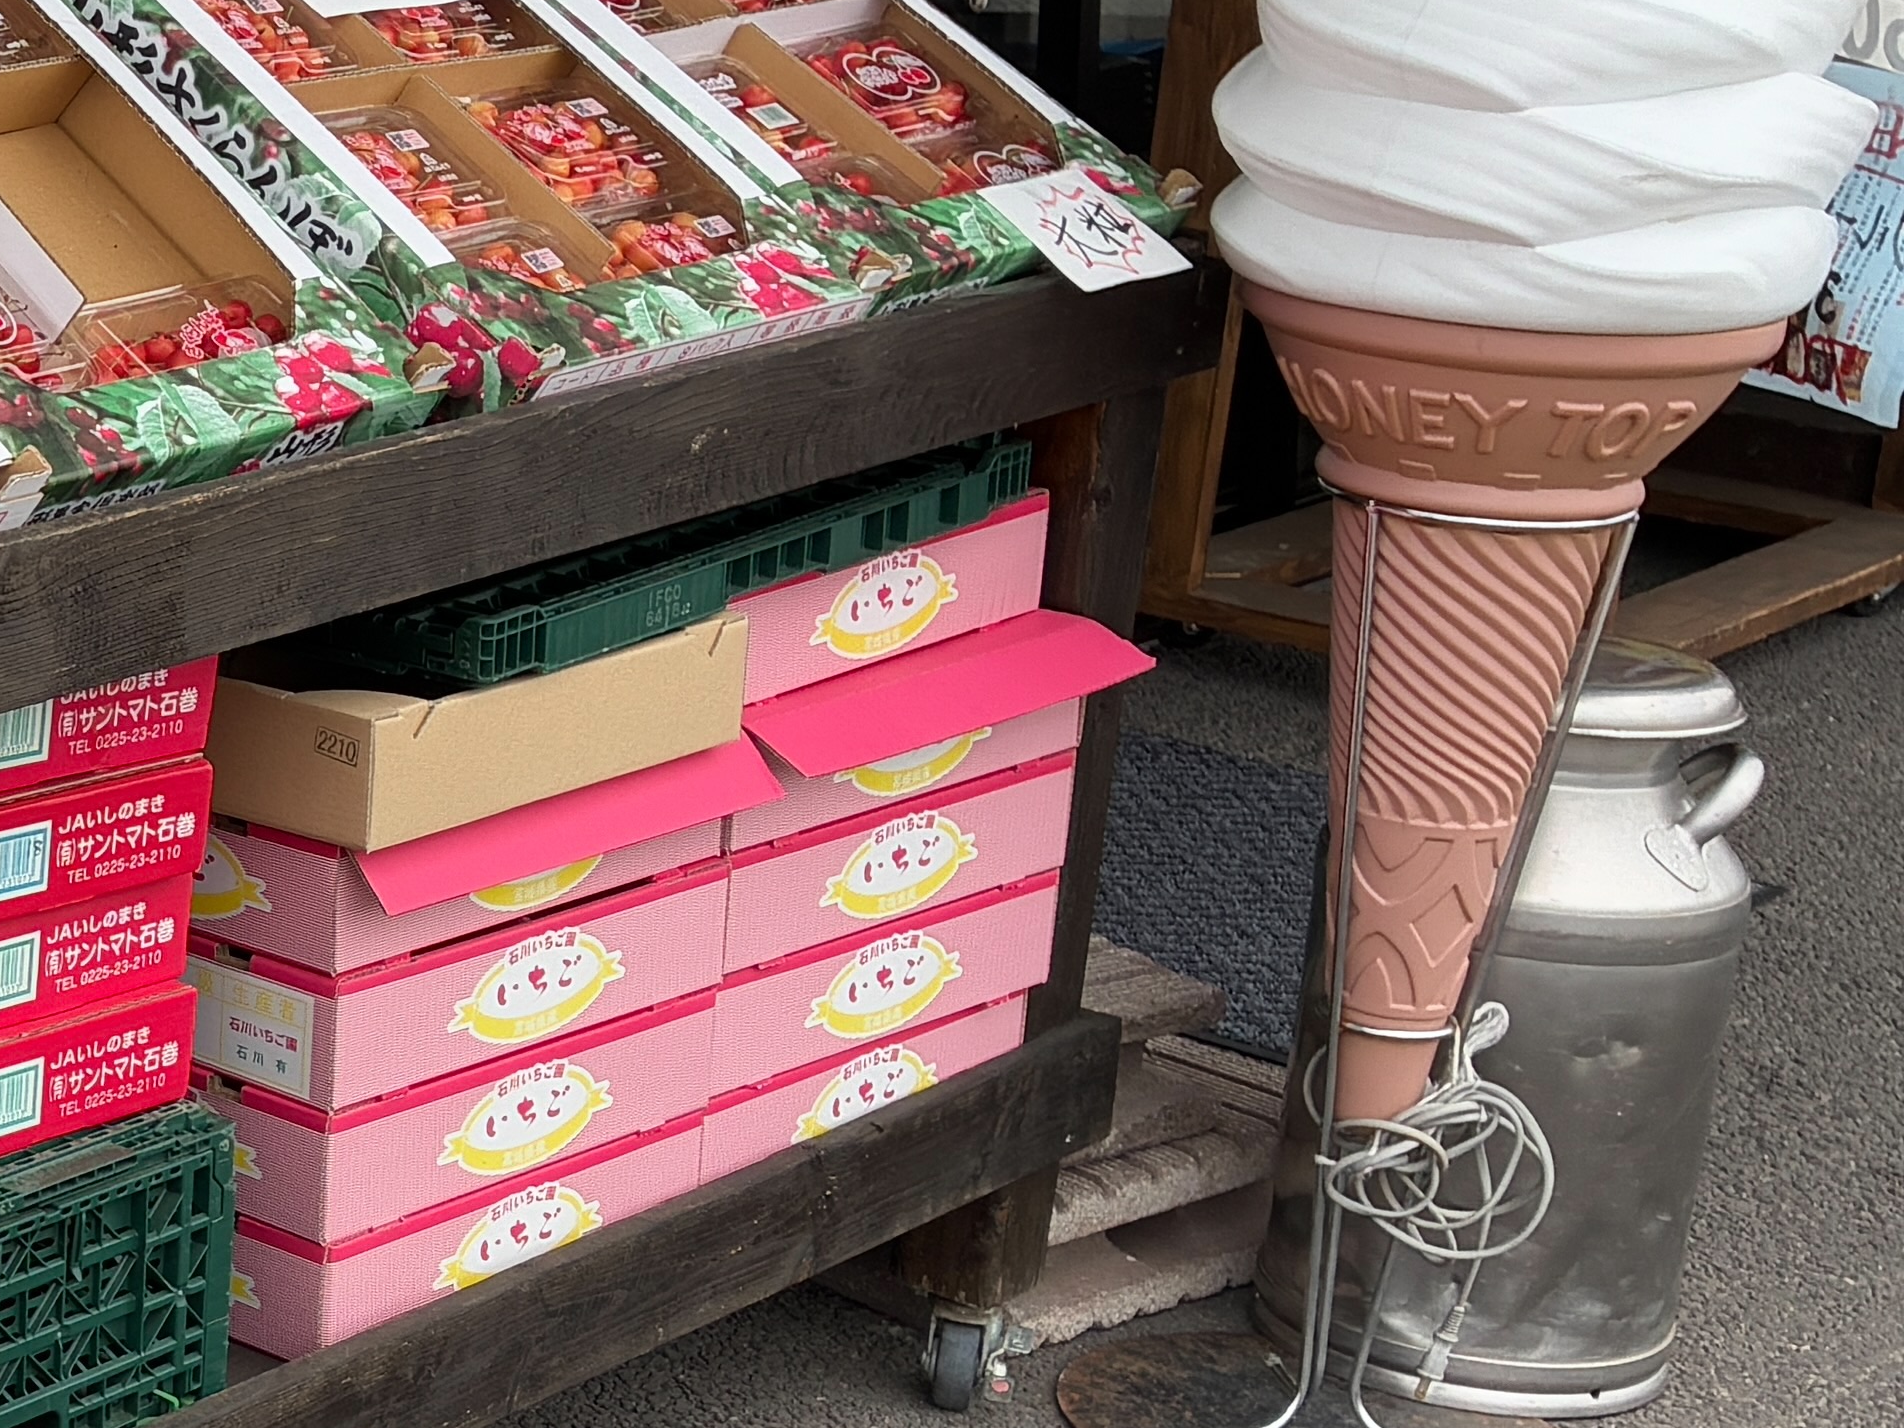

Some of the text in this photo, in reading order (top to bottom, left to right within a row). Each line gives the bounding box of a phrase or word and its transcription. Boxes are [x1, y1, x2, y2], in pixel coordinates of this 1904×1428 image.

[1550, 399, 1697, 461] TOP
[851, 575, 924, 622] いちご
[59, 667, 170, 705] JAいしのまき
[68, 718, 185, 756] TEL 0225-23-2110
[317, 729, 358, 765] 2210
[57, 793, 167, 835] JAいしのまき
[67, 844, 182, 884] TEL 0225-23-2110
[864, 835, 941, 884] いちご
[46, 900, 148, 945] JAいしのまき
[55, 949, 164, 994] TEL 0225-23-2110
[497, 954, 583, 1006] いちご
[848, 955, 925, 1003] いちご
[50, 1024, 152, 1071] JAいしのまき
[59, 1072, 168, 1117] TEL 0225-23-2110
[485, 1085, 572, 1138] いちご
[832, 1068, 904, 1118] いちご
[480, 1207, 562, 1262] いちご
